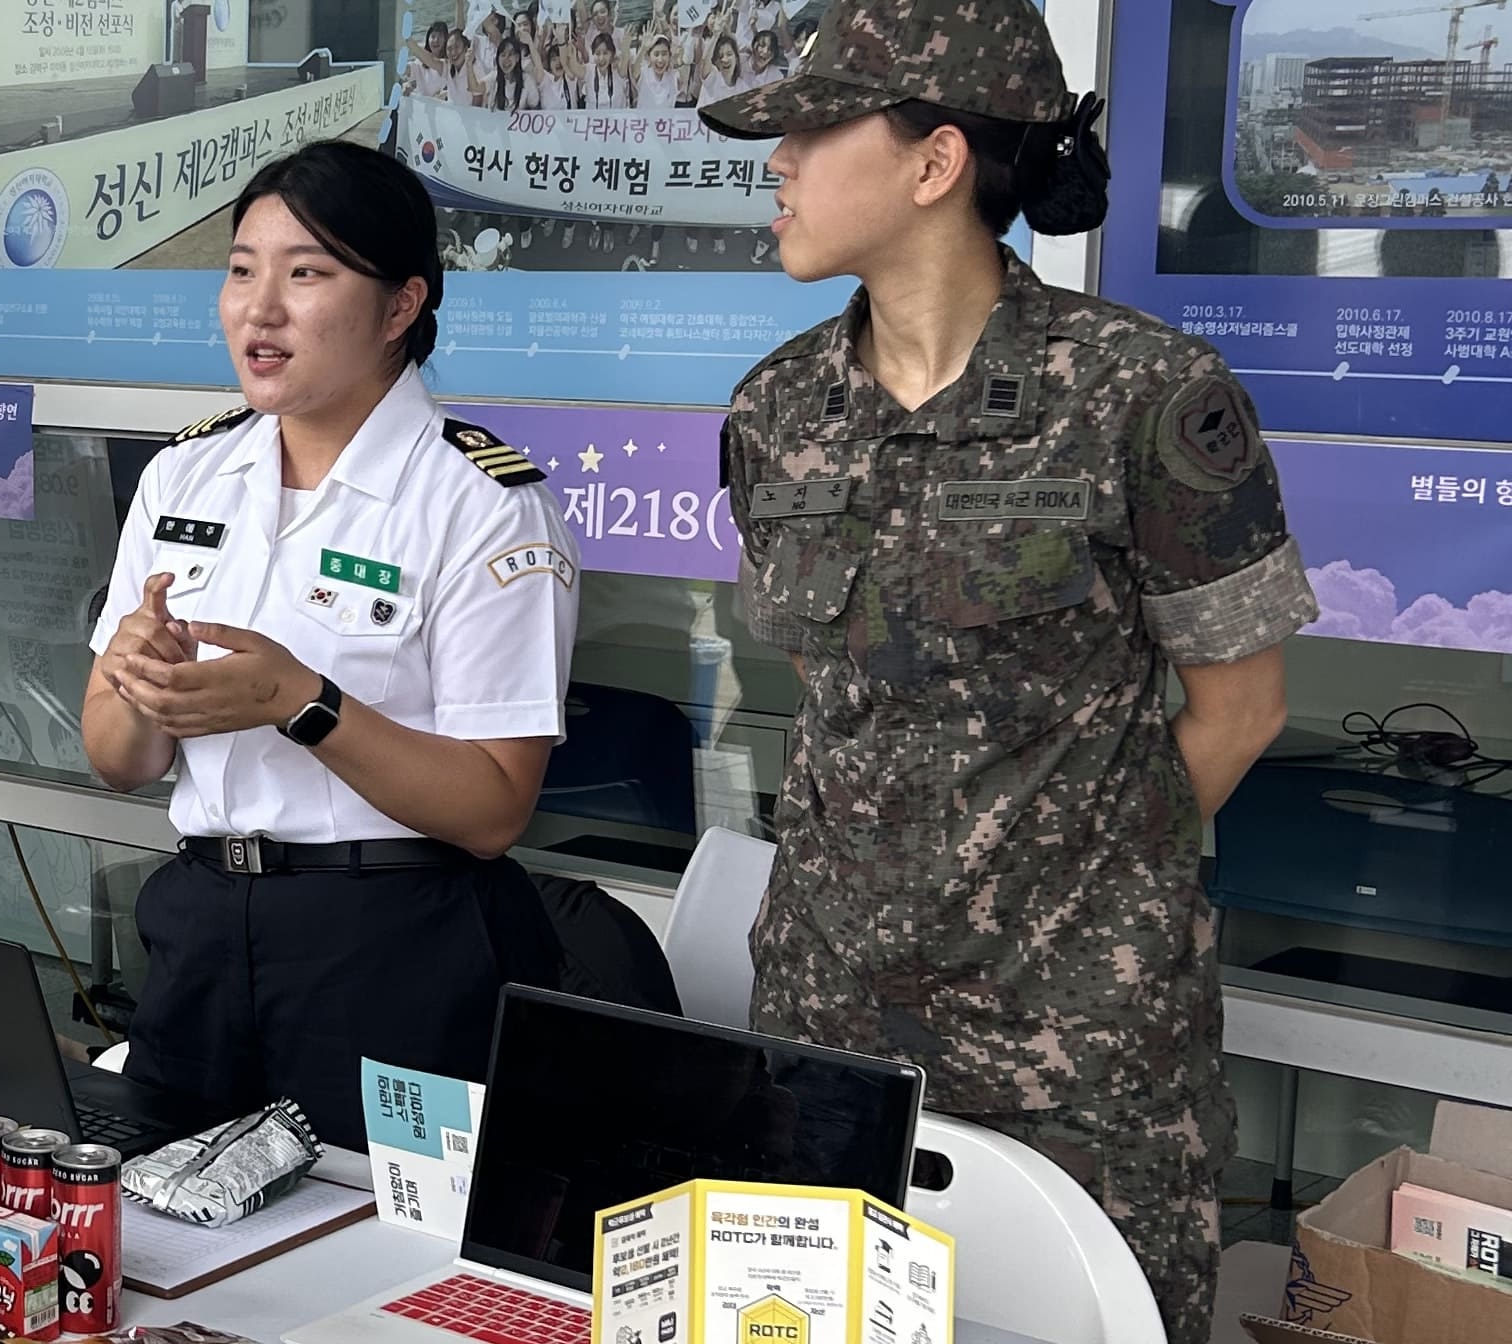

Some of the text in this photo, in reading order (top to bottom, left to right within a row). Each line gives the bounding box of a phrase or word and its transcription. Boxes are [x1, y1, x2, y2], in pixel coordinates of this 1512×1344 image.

[97, 14, 135, 37] 선포식
[507, 112, 556, 135] 2009
[85, 151, 164, 242] 성신
[173, 118, 274, 202] 제2캠퍼스
[462, 144, 784, 197] 역사 현장 체험 프로젝트
[1182, 306, 1245, 318] 2010.3.17.
[1337, 309, 1403, 322] 2010.6.17.
[1336, 324, 1410, 340] 입학사정관제
[1445, 327, 1479, 342] 3주기
[1388, 342, 1413, 357] 선정
[946, 493, 1001, 510] 대한민국
[1037, 490, 1081, 508] ROKA
[1410, 474, 1486, 505] 별들의
[506, 548, 568, 576] ROTC
[376, 1074, 394, 1119] 나만의
[392, 1078, 409, 1123] 스펙을
[407, 1081, 426, 1141] 완성하다
[70, 1173, 99, 1182] SUGAR
[387, 1161, 407, 1218] 거침없이
[50, 1188, 104, 1228] brrr
[753, 1214, 790, 1229] 인간의
[794, 1217, 819, 1231] 완성
[711, 1230, 838, 1250] ROTC가 함께합니다.
[749, 1324, 798, 1338] ROTC
